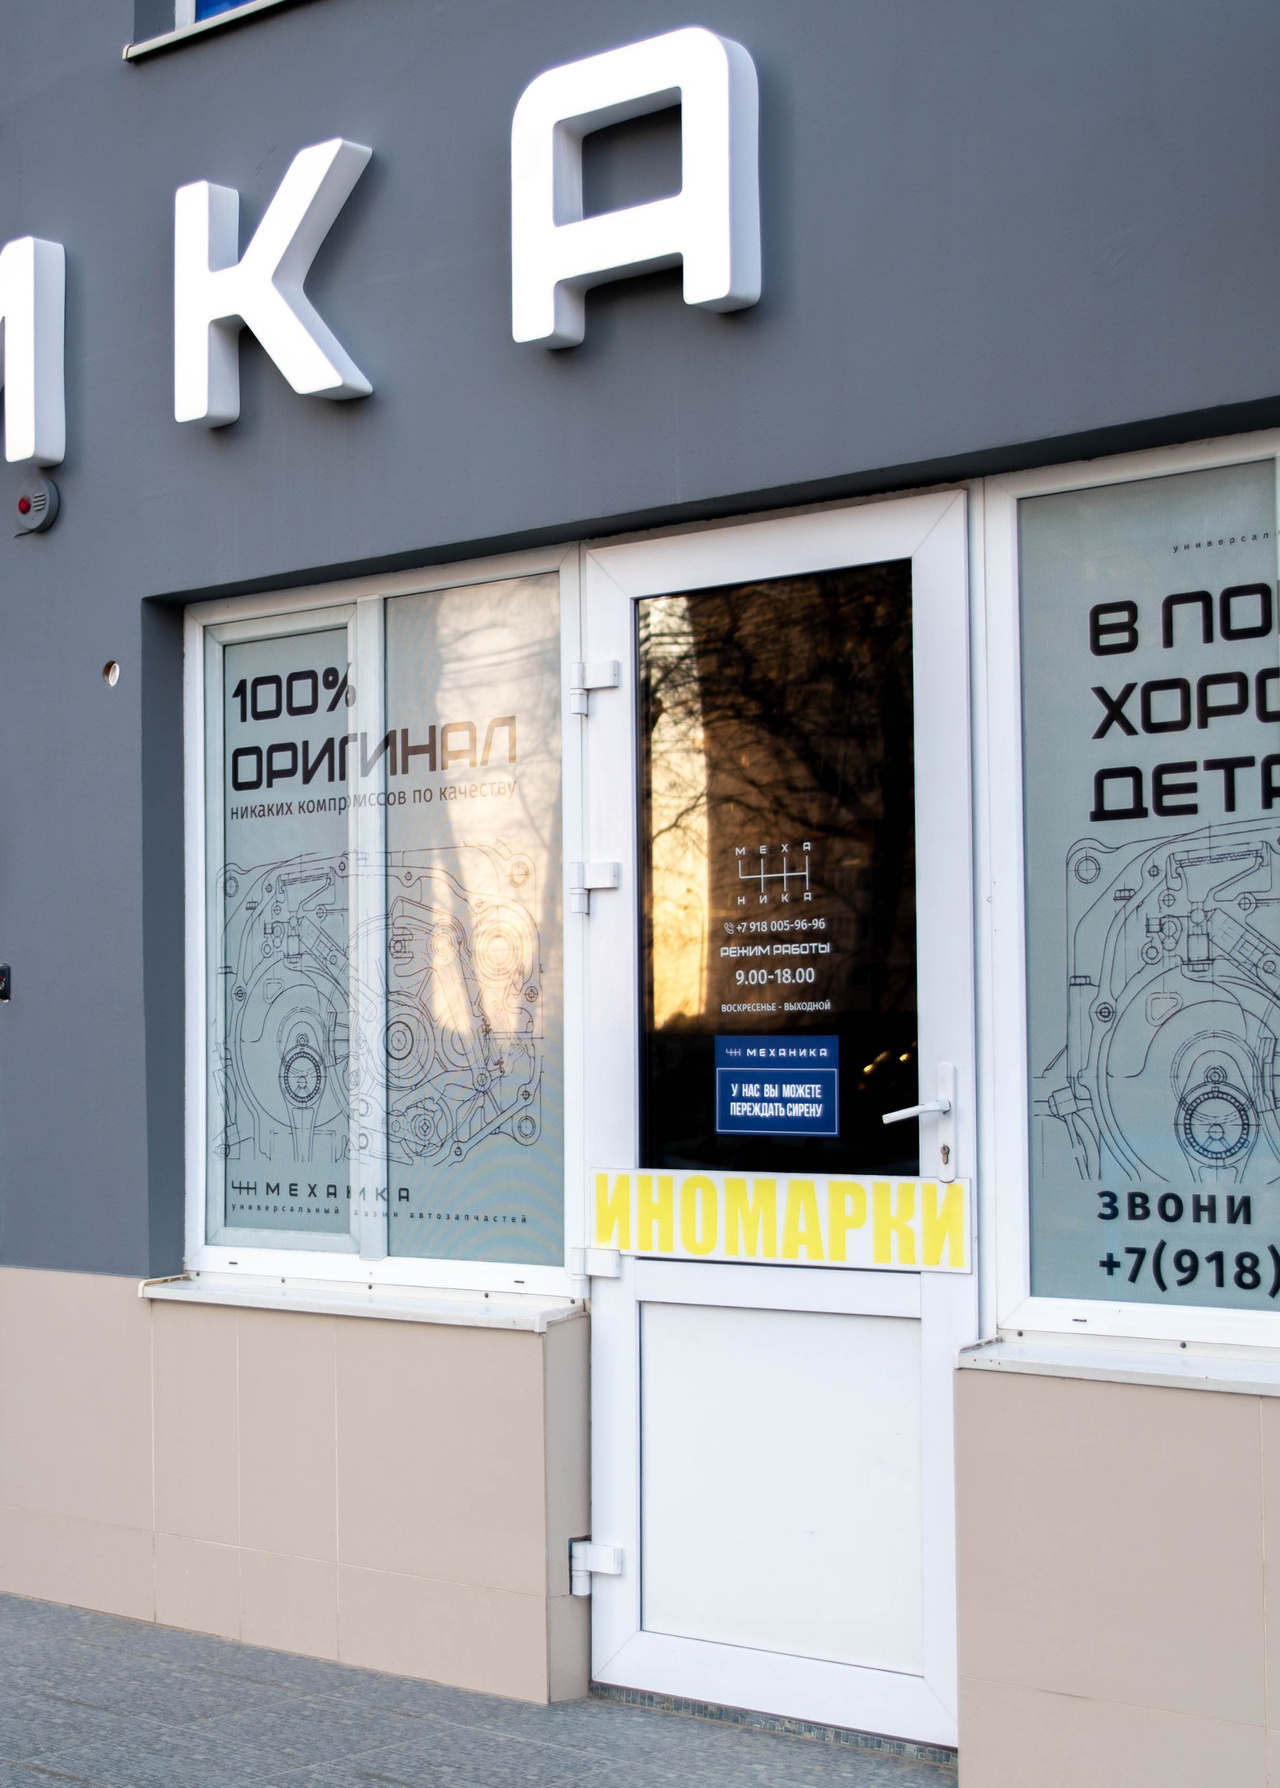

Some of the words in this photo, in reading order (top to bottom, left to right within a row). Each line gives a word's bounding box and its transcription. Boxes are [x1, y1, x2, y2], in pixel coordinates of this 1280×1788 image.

[1089, 600, 1138, 656] В
[1161, 582, 1280, 649] ПО
[232, 662, 357, 723] 100%
[231, 715, 517, 792] ОРИГИНАЛ
[230, 800, 293, 820] никаких
[412, 788, 433, 804] по
[439, 779, 518, 803] качеству
[736, 921, 747, 933] +7
[750, 921, 768, 933] 918
[770, 918, 826, 932] 005-96-96
[720, 945, 771, 957] РЕЖИМ
[772, 942, 830, 956] РАБОТЫ
[735, 967, 816, 986] 9.00-18.00
[721, 1002, 776, 1013] ВОСКРЕСЕНЬЕ
[783, 999, 831, 1012] ВЫХОДНОЙ
[746, 1048, 828, 1057] МЕХАНИКА
[731, 1083, 738, 1097] У
[742, 1083, 760, 1097] НАС
[763, 1084, 778, 1097] ВЫ
[782, 1084, 822, 1098] МОЖЕТЕ
[730, 1102, 786, 1117] ПЕРЕЖДАТЬ
[786, 1103, 823, 1117] СИРЕНУ
[231, 1202, 340, 1215] универсальный
[409, 1210, 527, 1224] автозапчастей
[1097, 1190, 1252, 1225] ЗВОНИ
[595, 1172, 966, 1268] ИНОМАРКИ
[1099, 1239, 1280, 1299] +7(918)
